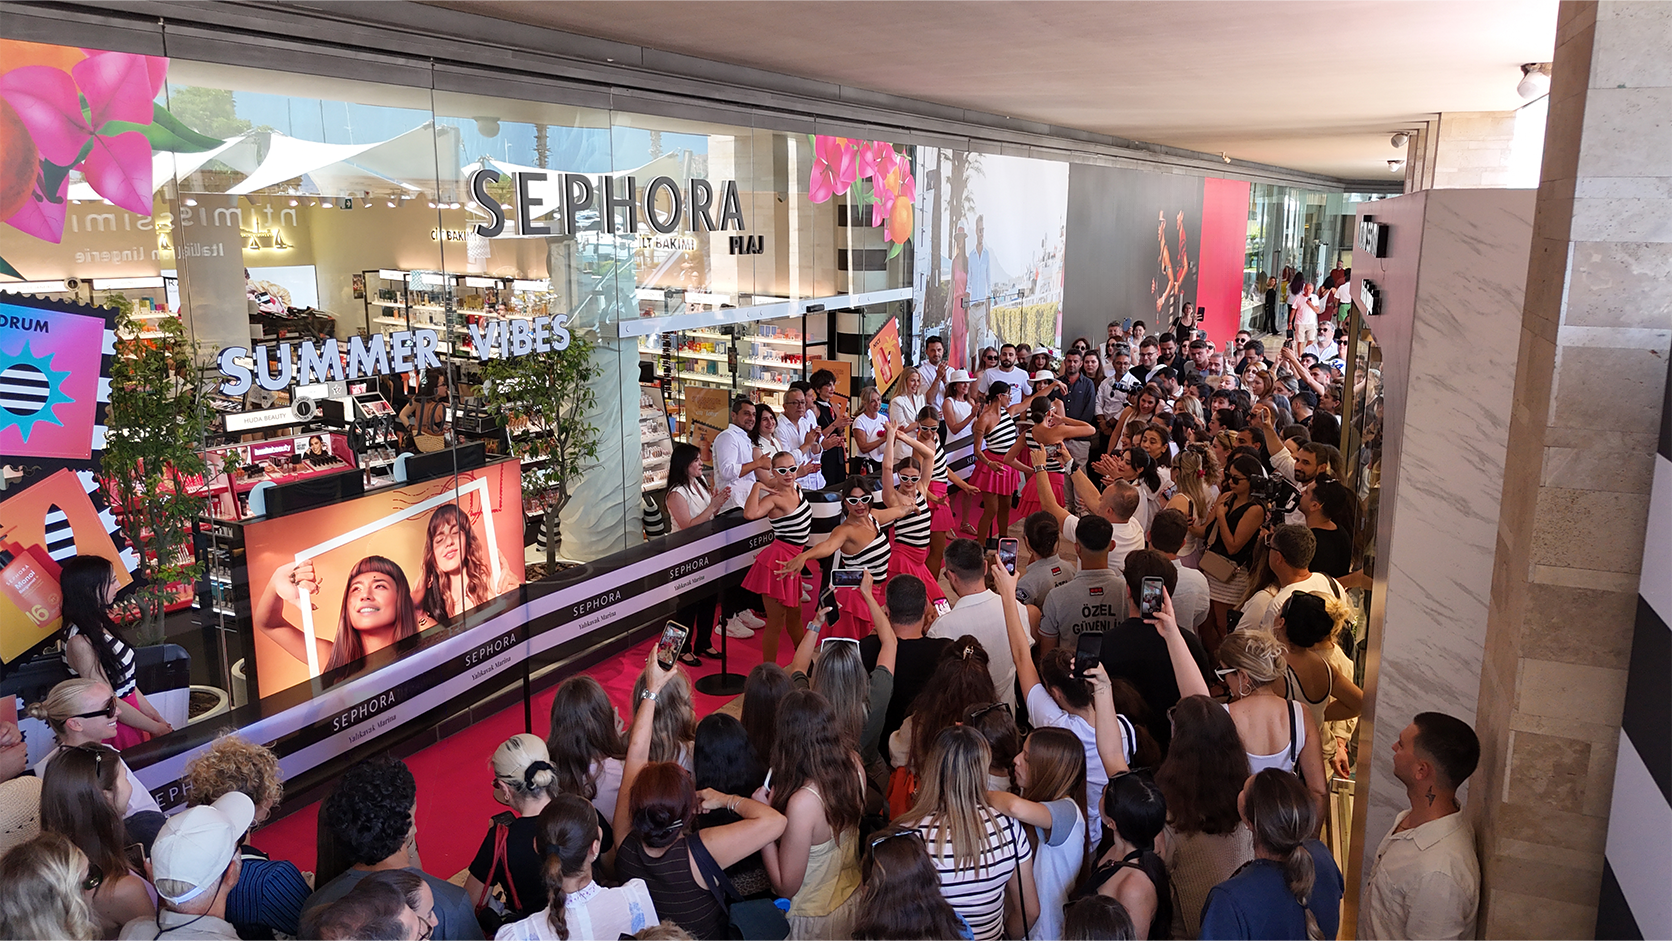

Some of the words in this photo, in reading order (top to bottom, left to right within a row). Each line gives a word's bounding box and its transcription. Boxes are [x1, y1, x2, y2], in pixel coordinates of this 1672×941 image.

[466, 168, 746, 238] SEPHORA
[728, 235, 765, 256] PLAJ
[216, 328, 443, 398] SUMMER
[468, 313, 572, 361] VIBES
[243, 416, 263, 425] HUDA
[264, 412, 287, 422] BEAUTY
[749, 532, 776, 549] SEPHO
[669, 556, 710, 579] SEPHORA
[572, 590, 622, 617] SEPHORA
[1081, 603, 1116, 618] ÖZEL
[464, 632, 517, 667] SEPHORA
[332, 690, 396, 732] SEPHORA
